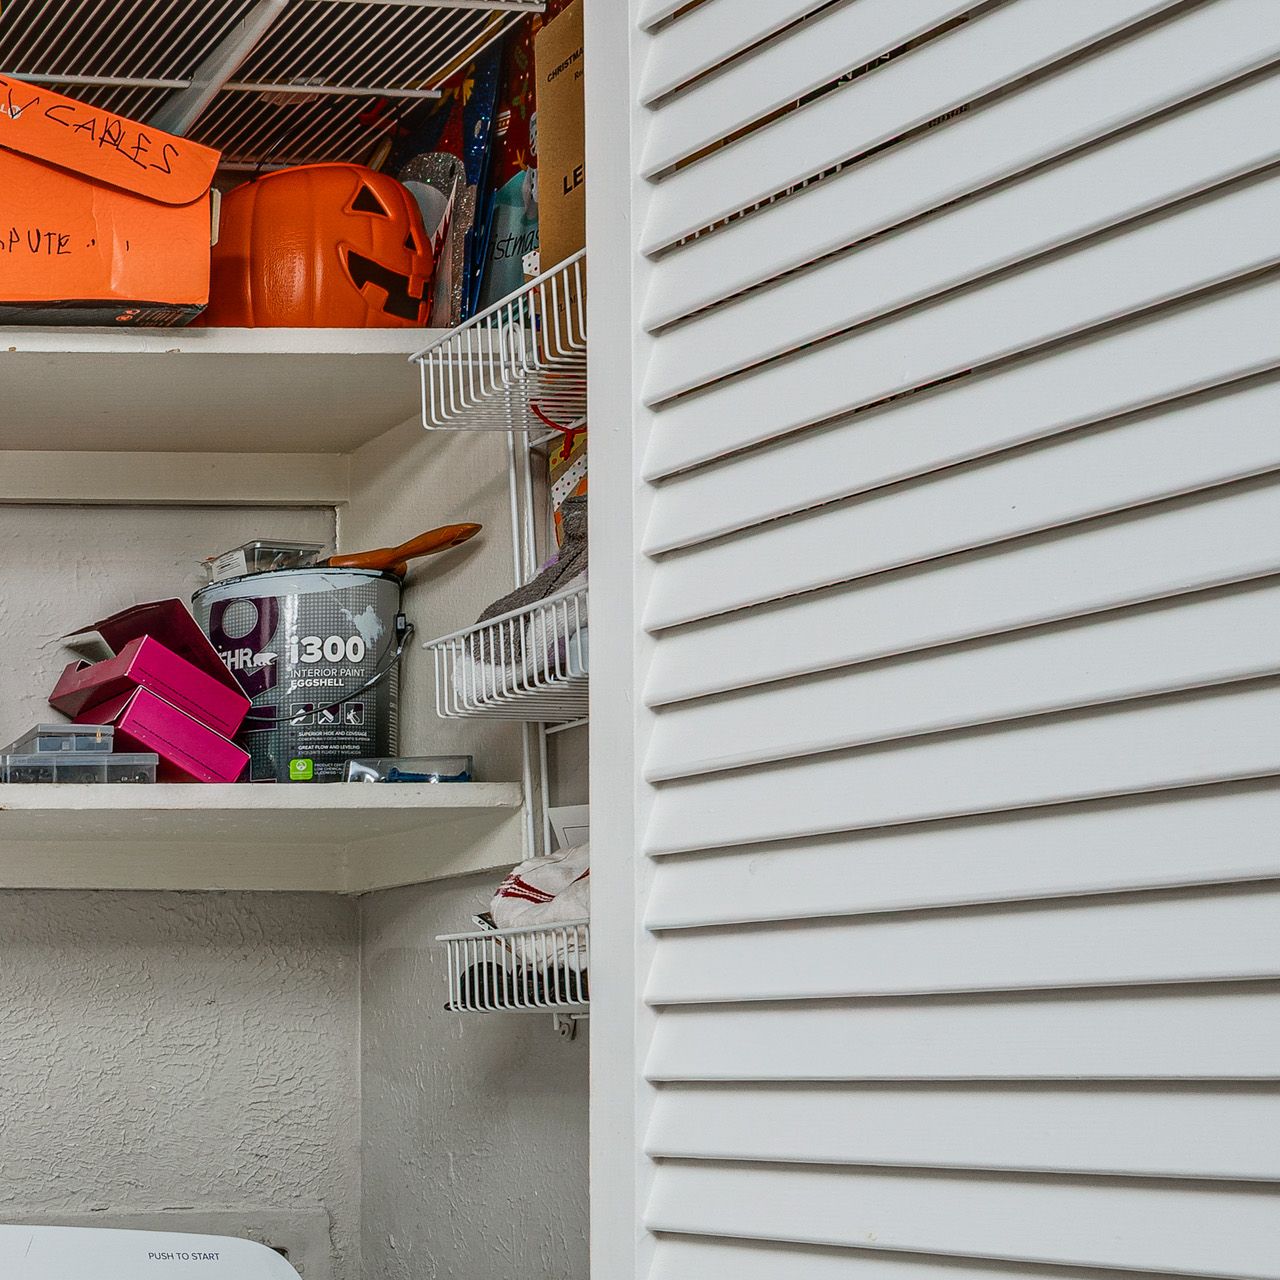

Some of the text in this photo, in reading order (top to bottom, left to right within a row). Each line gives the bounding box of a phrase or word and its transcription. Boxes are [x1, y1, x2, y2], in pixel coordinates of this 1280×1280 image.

[290, 668, 365, 678] INTERIOR PAINT
[291, 678, 345, 687] EGGSHELL
[148, 1252, 220, 1260] PUSH TO START
